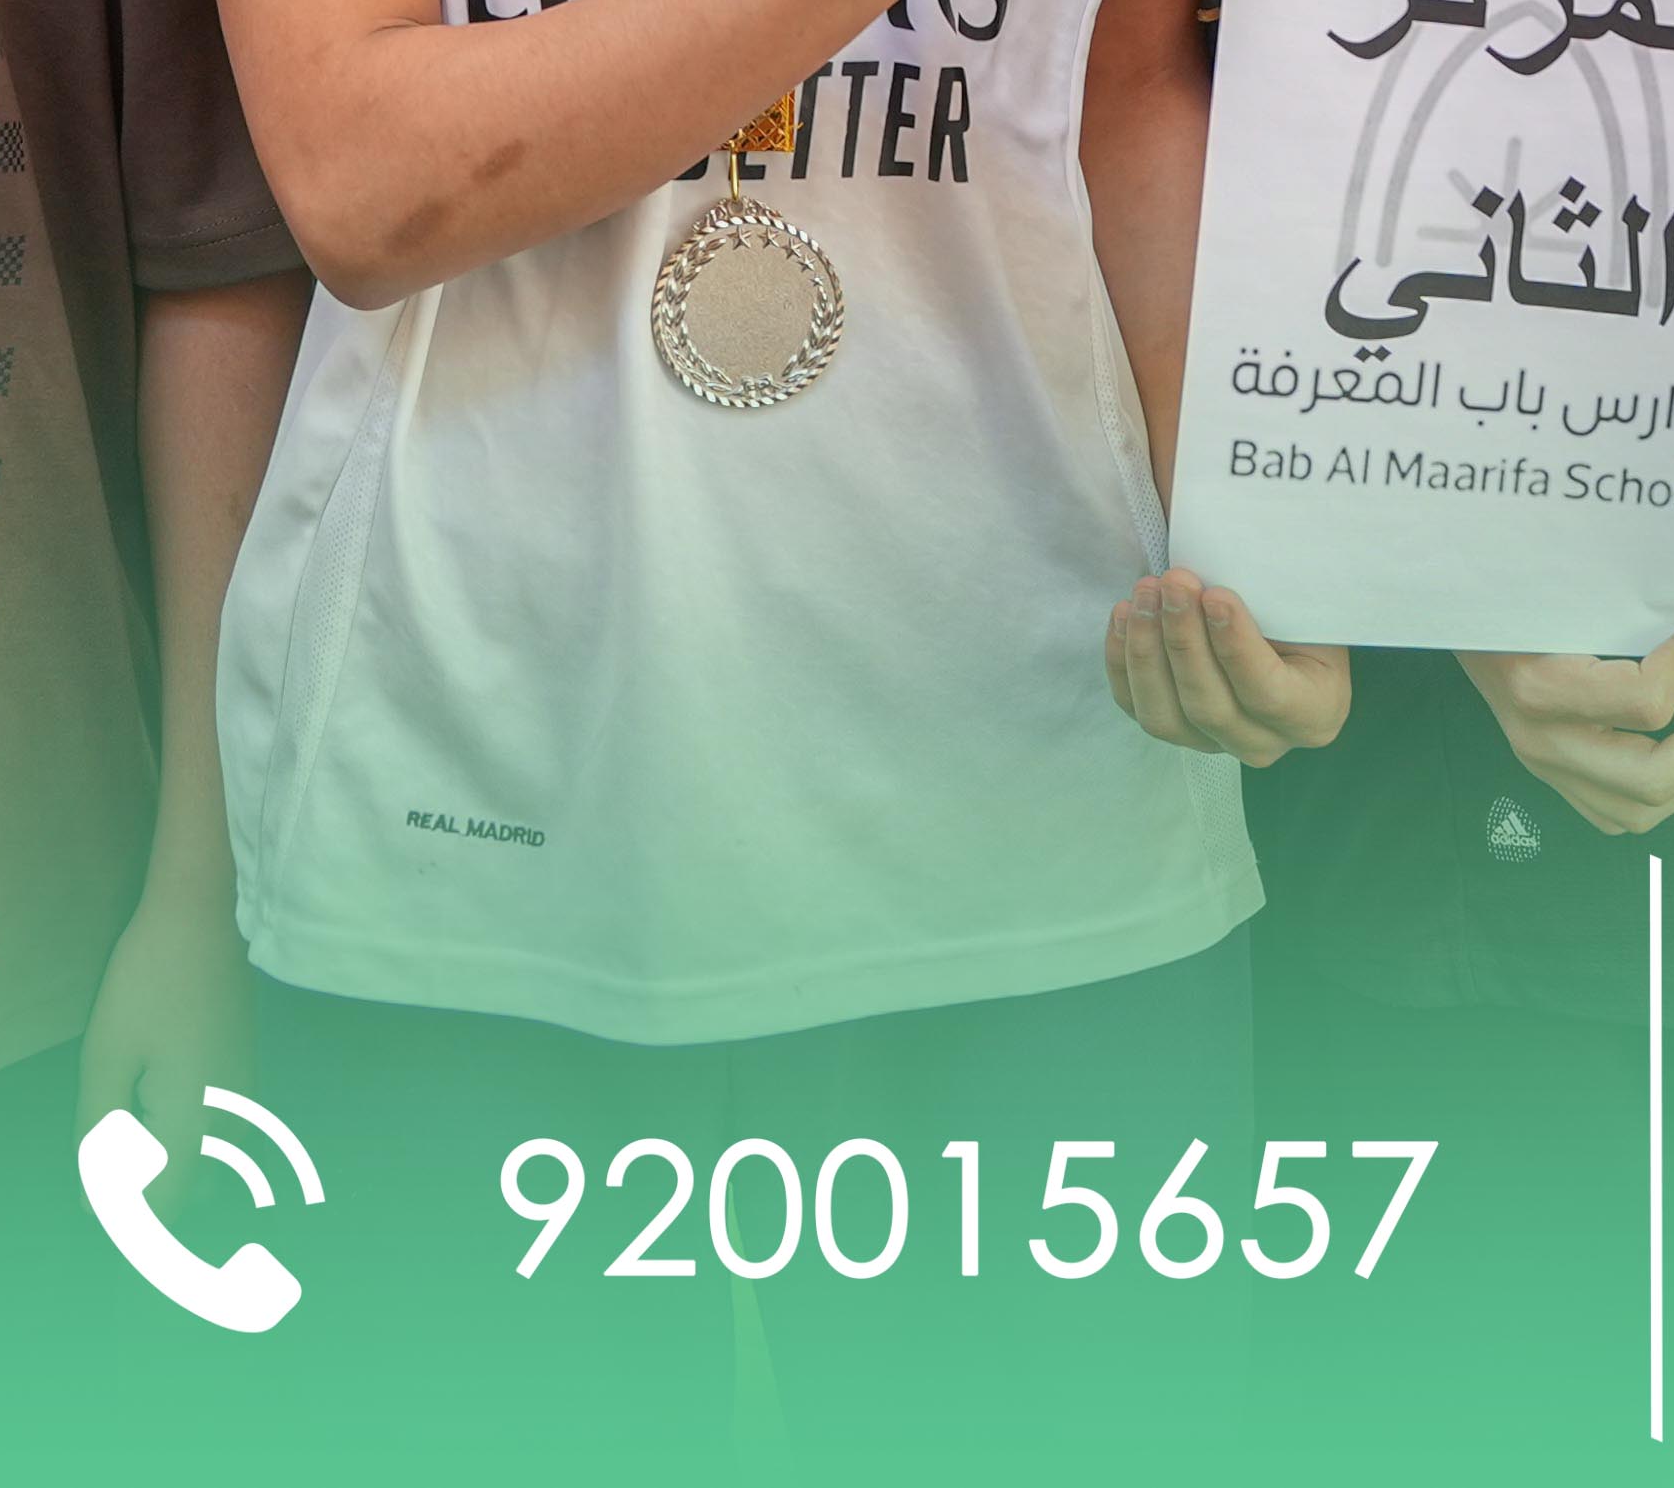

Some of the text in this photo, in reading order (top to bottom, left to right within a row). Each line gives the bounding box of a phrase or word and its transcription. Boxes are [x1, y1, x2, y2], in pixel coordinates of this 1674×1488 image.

[673, 61, 971, 183] TTER
[1231, 347, 1442, 414] المعرفة
[1459, 369, 1545, 431] باب
[1230, 439, 1312, 481] Bab
[1325, 447, 1369, 485] Al
[1385, 450, 1550, 497] Maarifa
[406, 810, 546, 848] REAL MADRID
[1491, 832, 1537, 848] adidas
